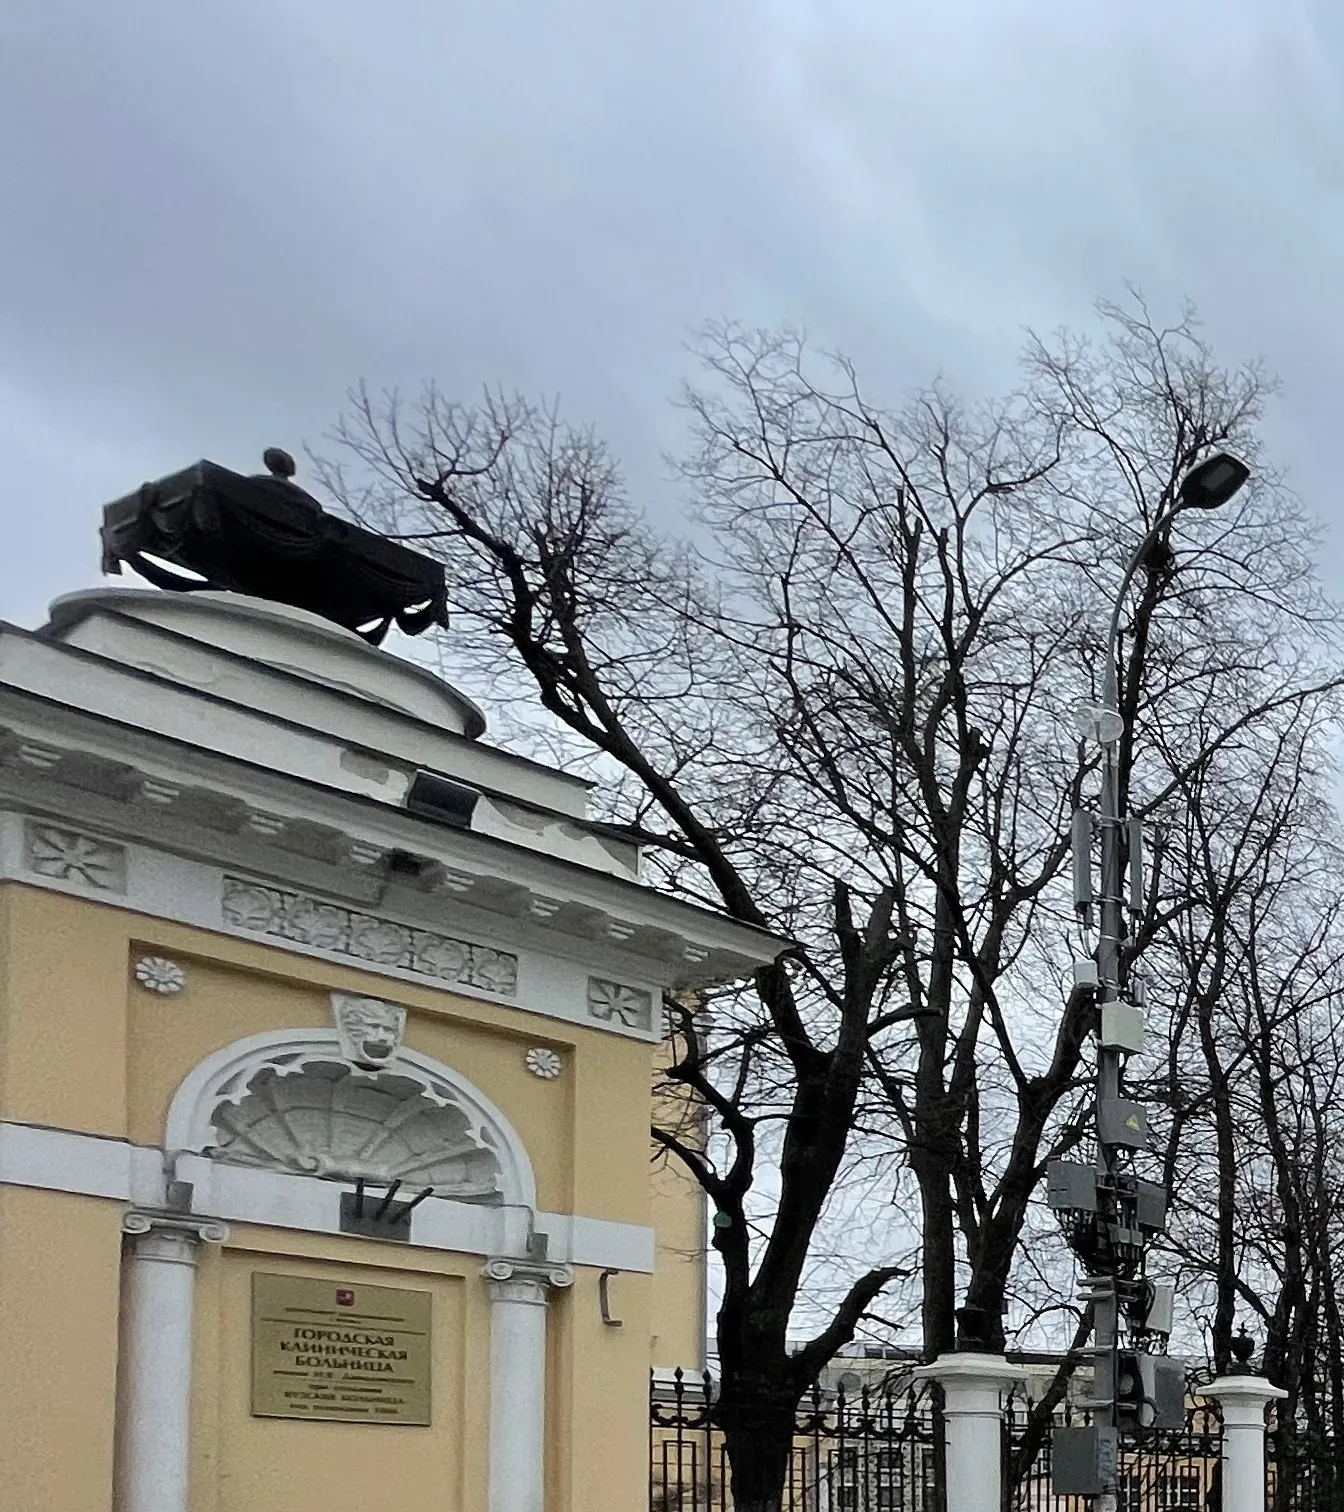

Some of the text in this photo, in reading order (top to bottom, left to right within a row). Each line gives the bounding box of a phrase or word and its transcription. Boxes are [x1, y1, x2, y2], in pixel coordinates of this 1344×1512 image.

[294, 1328, 395, 1346] ГОРОДСКАЯ
[280, 1341, 408, 1361] КЛИНИЧЕСКАЯ
[295, 1356, 397, 1373] БОЛЬНИЦА
